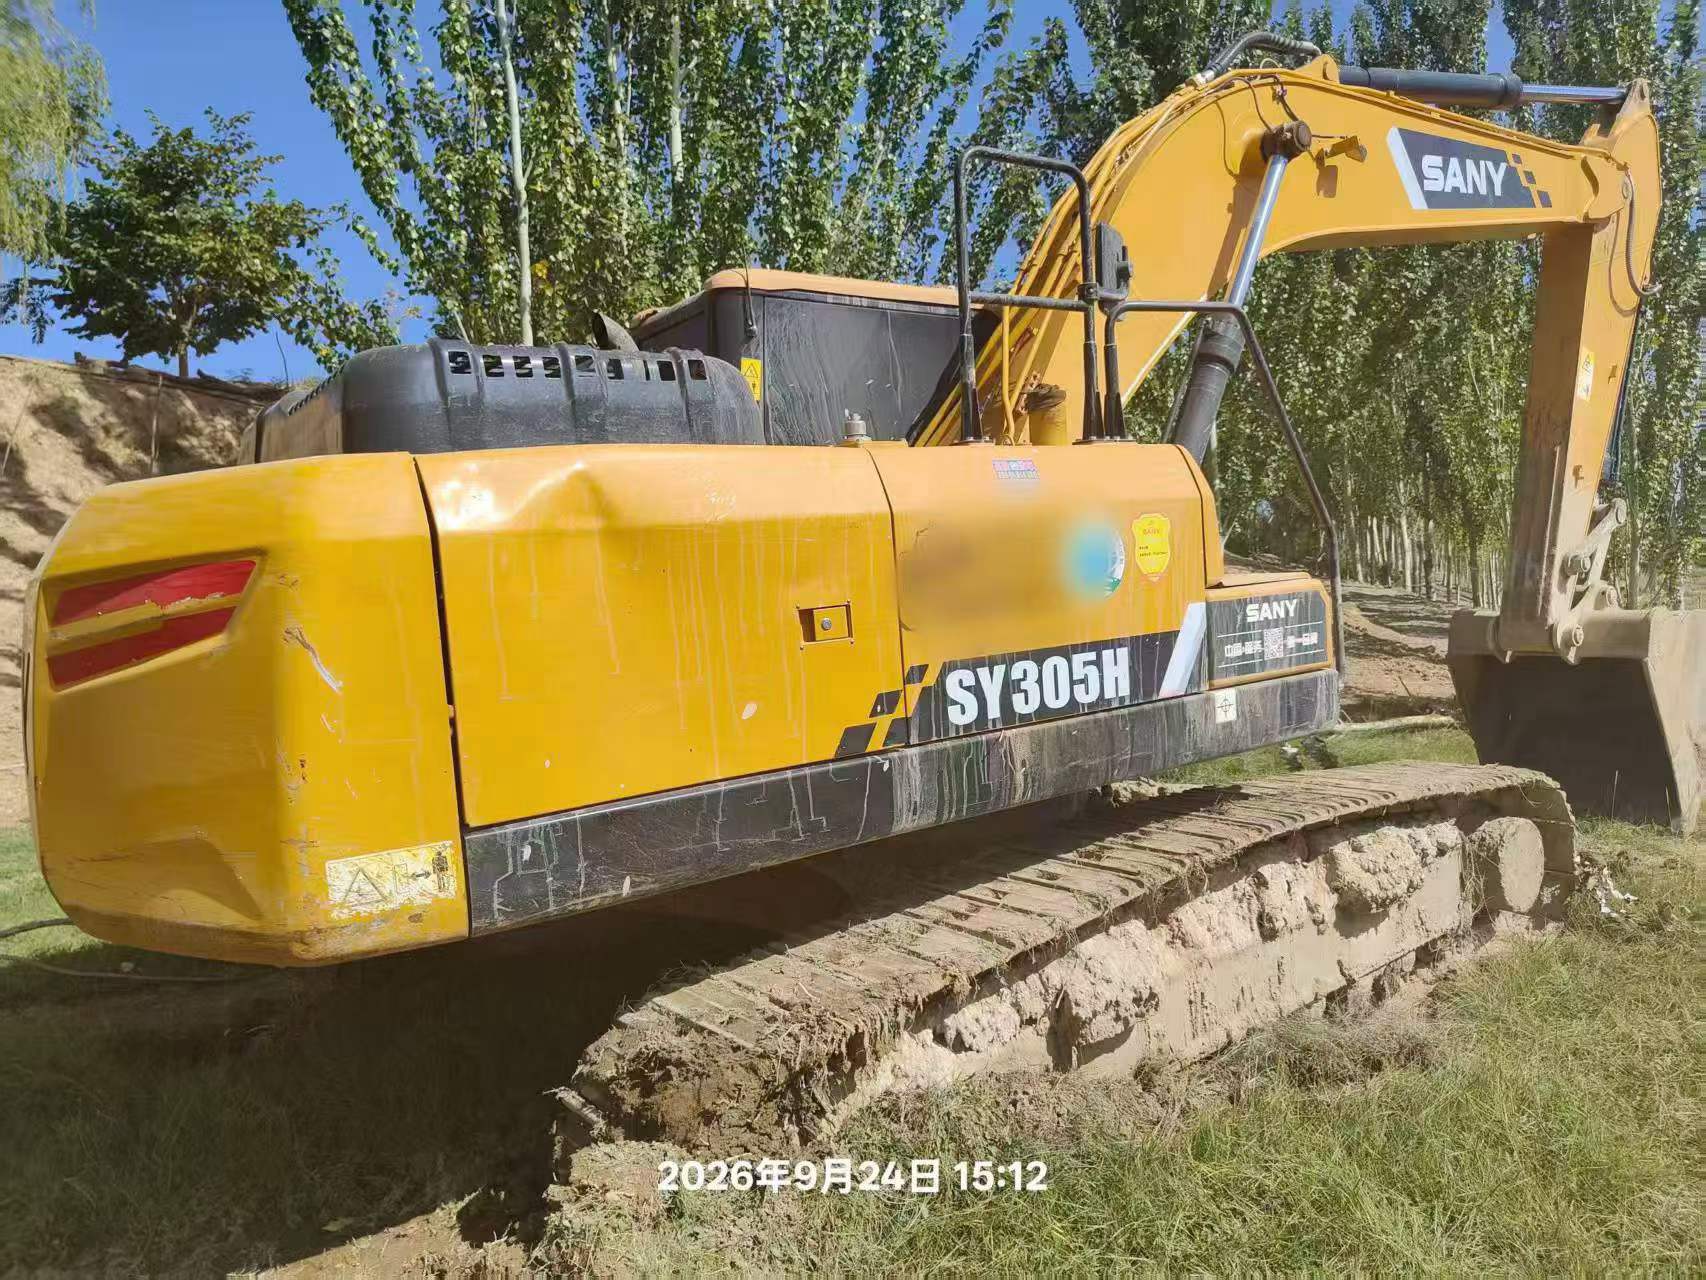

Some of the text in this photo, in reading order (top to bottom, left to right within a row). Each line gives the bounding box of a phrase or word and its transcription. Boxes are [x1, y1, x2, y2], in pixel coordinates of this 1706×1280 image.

[1421, 154, 1507, 197] SANY
[1246, 599, 1297, 622] SANY
[945, 647, 1130, 726] SY305H
